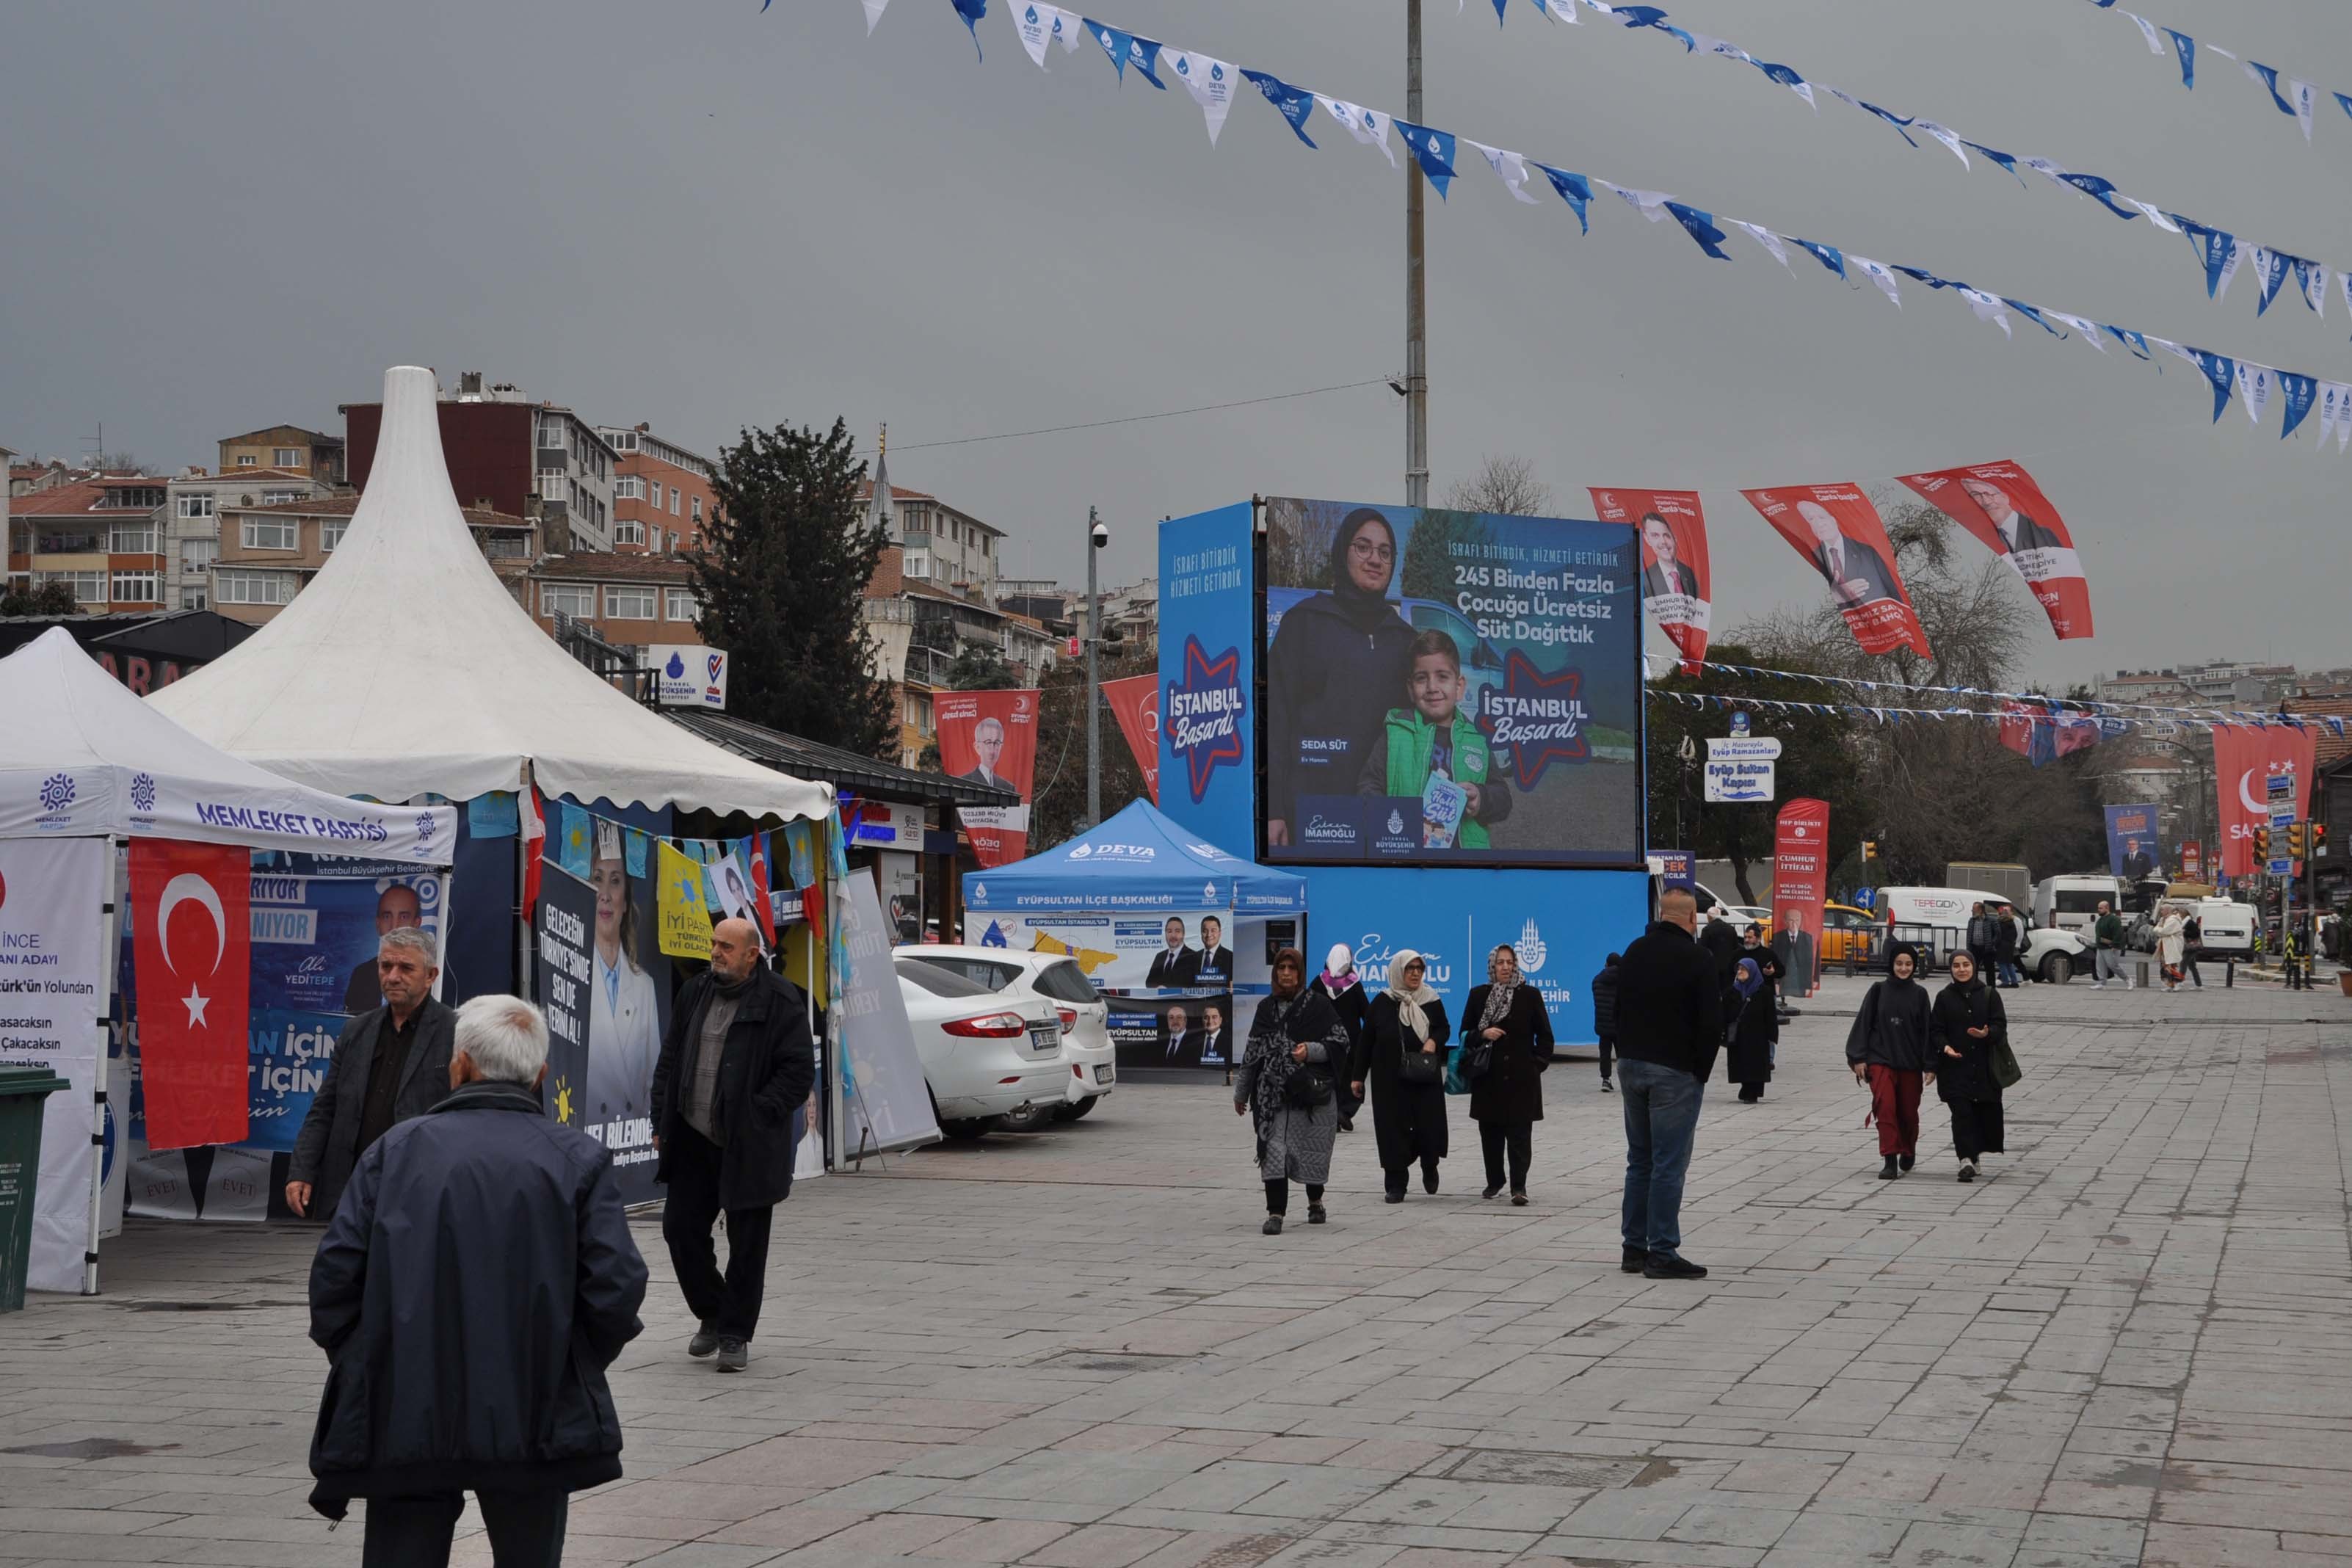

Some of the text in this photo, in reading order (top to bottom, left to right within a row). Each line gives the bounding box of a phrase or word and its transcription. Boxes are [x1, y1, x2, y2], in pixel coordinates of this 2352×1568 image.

[1208, 81, 1226, 90] DEVA
[1281, 103, 1300, 114] DEVA
[1173, 544, 1236, 575] İSRAFI BİTİRDİK
[1448, 540, 1479, 556] İSRAFI
[1533, 546, 1571, 564] HİZMETİ
[1575, 551, 1619, 567] GETİRDİK
[1170, 567, 1241, 599] HİZMETİ GETİRDİK
[1454, 565, 1614, 594] 245 Binden Fazla
[1457, 592, 1612, 619] Çocuğa Ücretsiz
[1477, 619, 1594, 646] Süt Dağıttık
[1170, 687, 1242, 716] İSTANBUL
[1484, 691, 1588, 719] İSTANBUL
[1175, 703, 1233, 749] Başardı
[1492, 712, 1578, 745] Başardı
[1302, 739, 1348, 750] SEDA SÜT
[1709, 763, 1770, 777] Eyüp Sultan
[1722, 777, 1756, 789] Kapısı
[197, 802, 388, 842] MEMLEKET PARTİSİ
[1305, 827, 1355, 838] İMAMOĞLU
[1095, 844, 1155, 857] DEVA
[1779, 854, 1815, 863] CUMHUR
[317, 865, 351, 875] İstanbul
[352, 864, 395, 876] Büyükşehir
[1781, 863, 1813, 872] İTTİFAKI
[250, 877, 300, 900] RIYOR
[1017, 894, 1173, 907] EYÜPSULTAN İLÇE BAŞKANLIĞI
[253, 912, 308, 940] NIYOR
[545, 903, 584, 948] GELECEĞİN
[667, 911, 684, 929] İYİ
[3, 931, 40, 948] İNCE
[1115, 937, 1161, 945] EYÜPSULTAN
[21, 954, 57, 965] ADAYI
[540, 929, 590, 984] TÜRKİYE'SİNDE
[43, 980, 93, 995] Yolundan
[286, 973, 335, 985] YEDİTEPE
[552, 973, 576, 1010] SEN DE
[548, 1003, 568, 1040] YERİNİ
[1107, 1028, 1158, 1037] EYÜPSULTAN
[1, 1037, 61, 1051] Çakacaksın
[285, 1024, 338, 1064] İÇİN
[261, 1058, 323, 1099] İÇİN
[631, 1149, 650, 1165] Başkan
[148, 1180, 175, 1198] EVET
[222, 1178, 255, 1197] EVET
